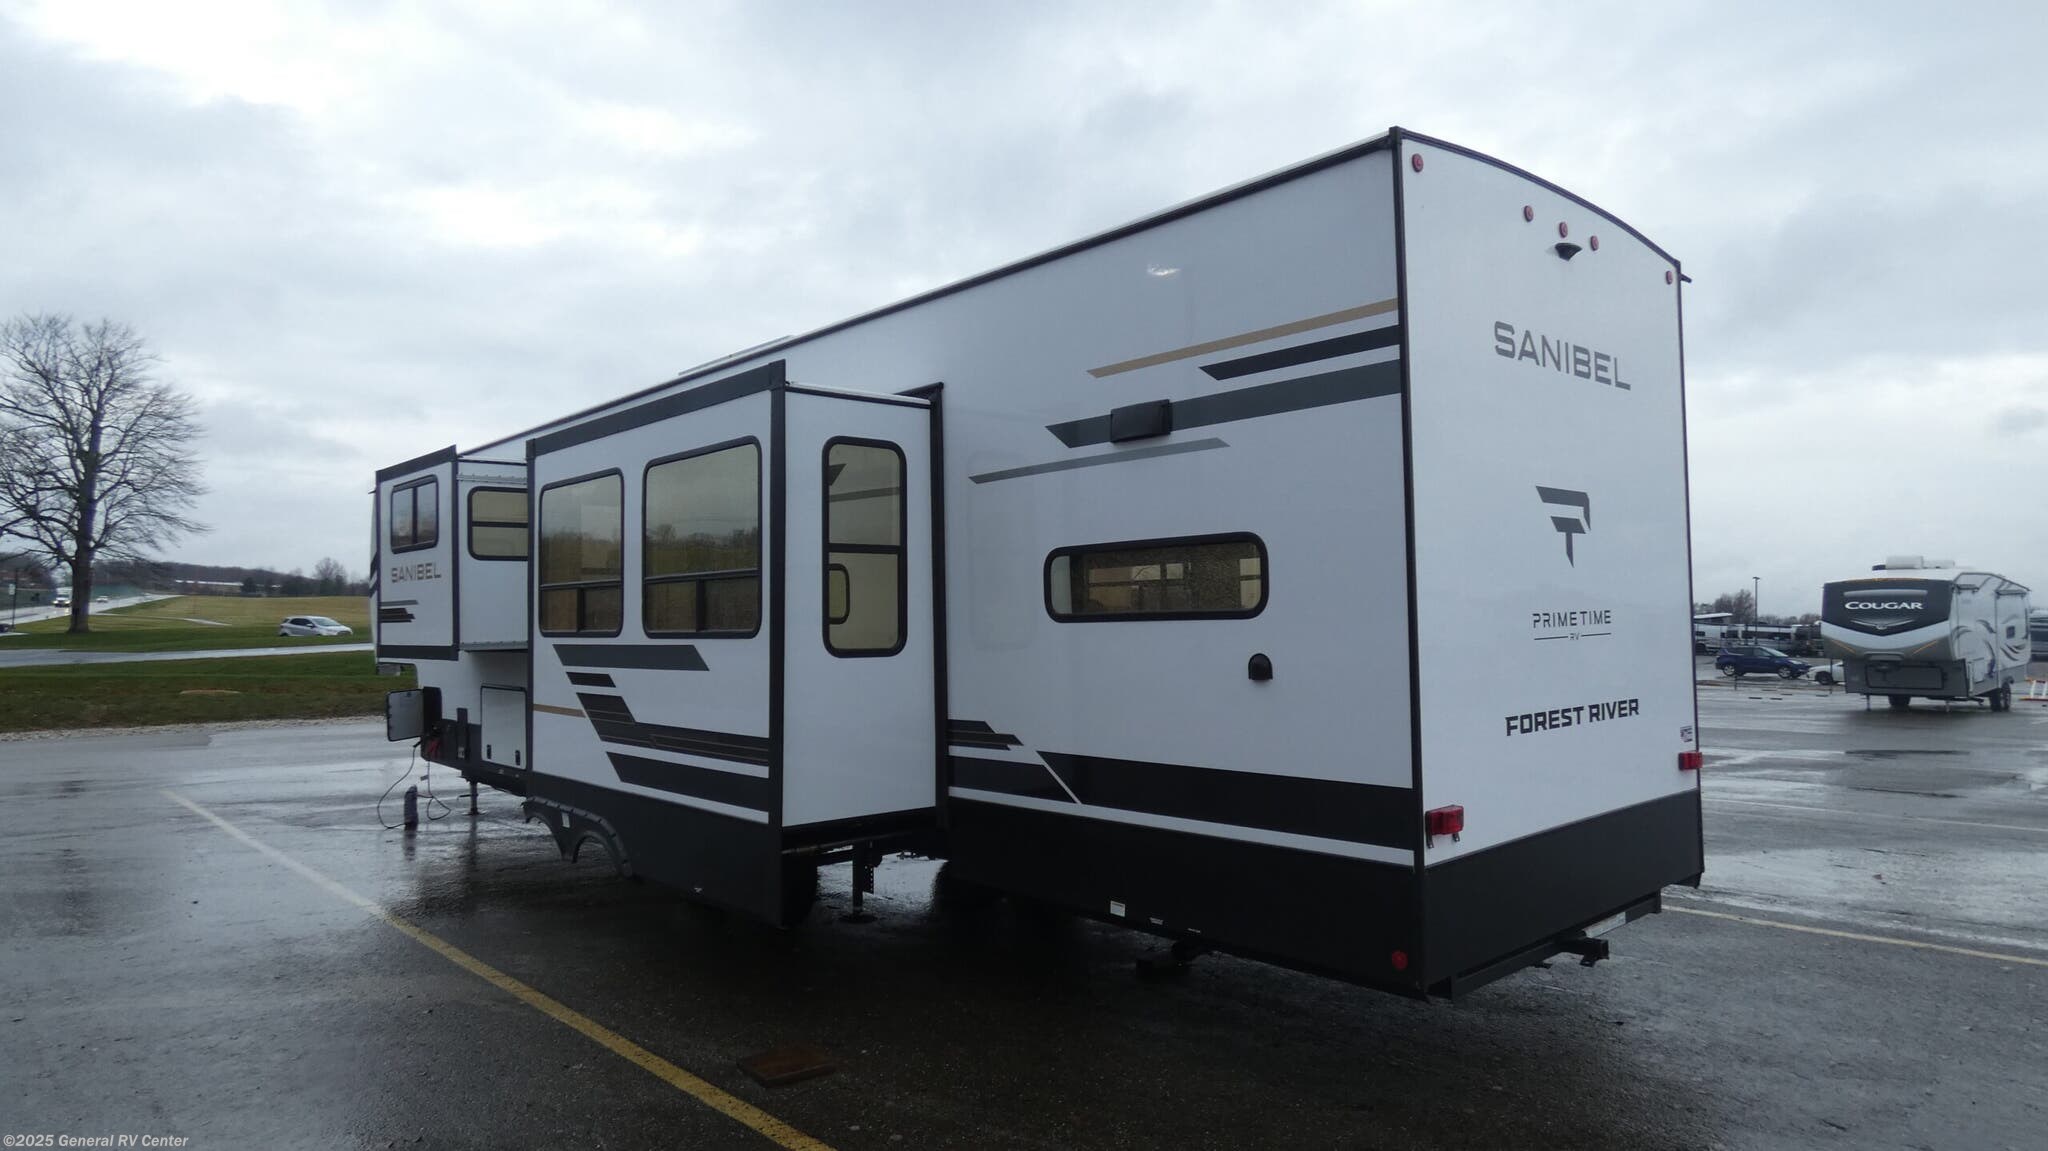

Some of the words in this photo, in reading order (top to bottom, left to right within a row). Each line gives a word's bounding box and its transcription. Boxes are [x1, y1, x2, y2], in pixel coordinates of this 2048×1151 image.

[1494, 320, 1631, 391] SANIBEL
[391, 562, 441, 583] SANIBEL
[1844, 601, 1924, 610] COUGAR
[1505, 706, 1584, 737] FOREST
[1588, 698, 1640, 723] RIVER
